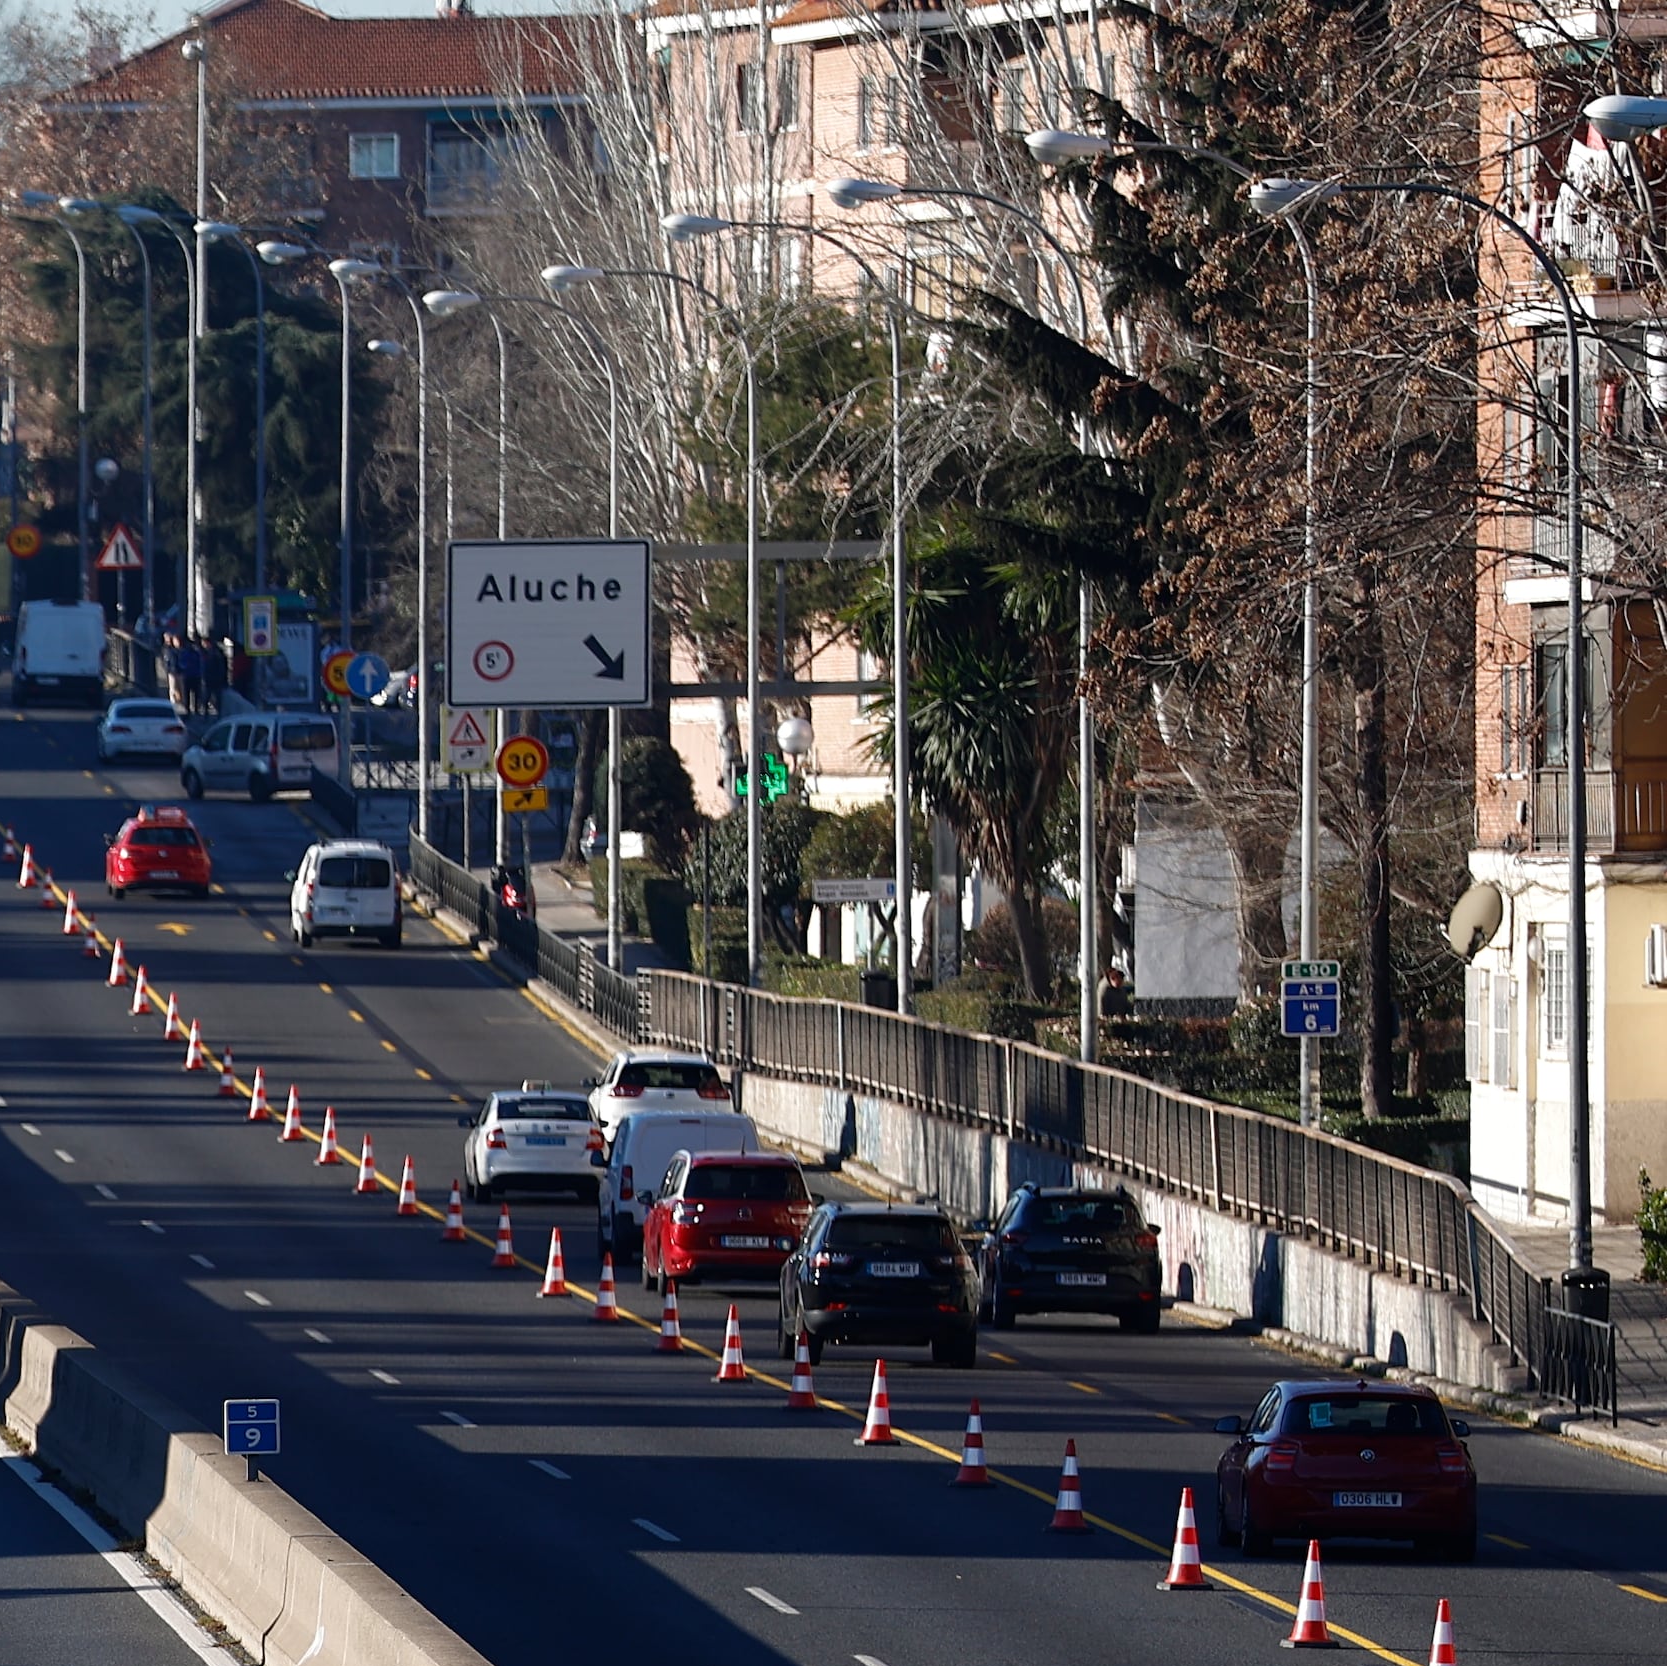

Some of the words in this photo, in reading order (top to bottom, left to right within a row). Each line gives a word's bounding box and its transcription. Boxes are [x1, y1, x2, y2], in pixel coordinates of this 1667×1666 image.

[476, 573, 622, 602] Aluche
[508, 753, 537, 772] 30
[1299, 983, 1323, 995] A-5
[1302, 1000, 1320, 1012] km
[1304, 1013, 1317, 1031] 6
[247, 1406, 257, 1418] 5
[245, 1428, 261, 1447] 9
